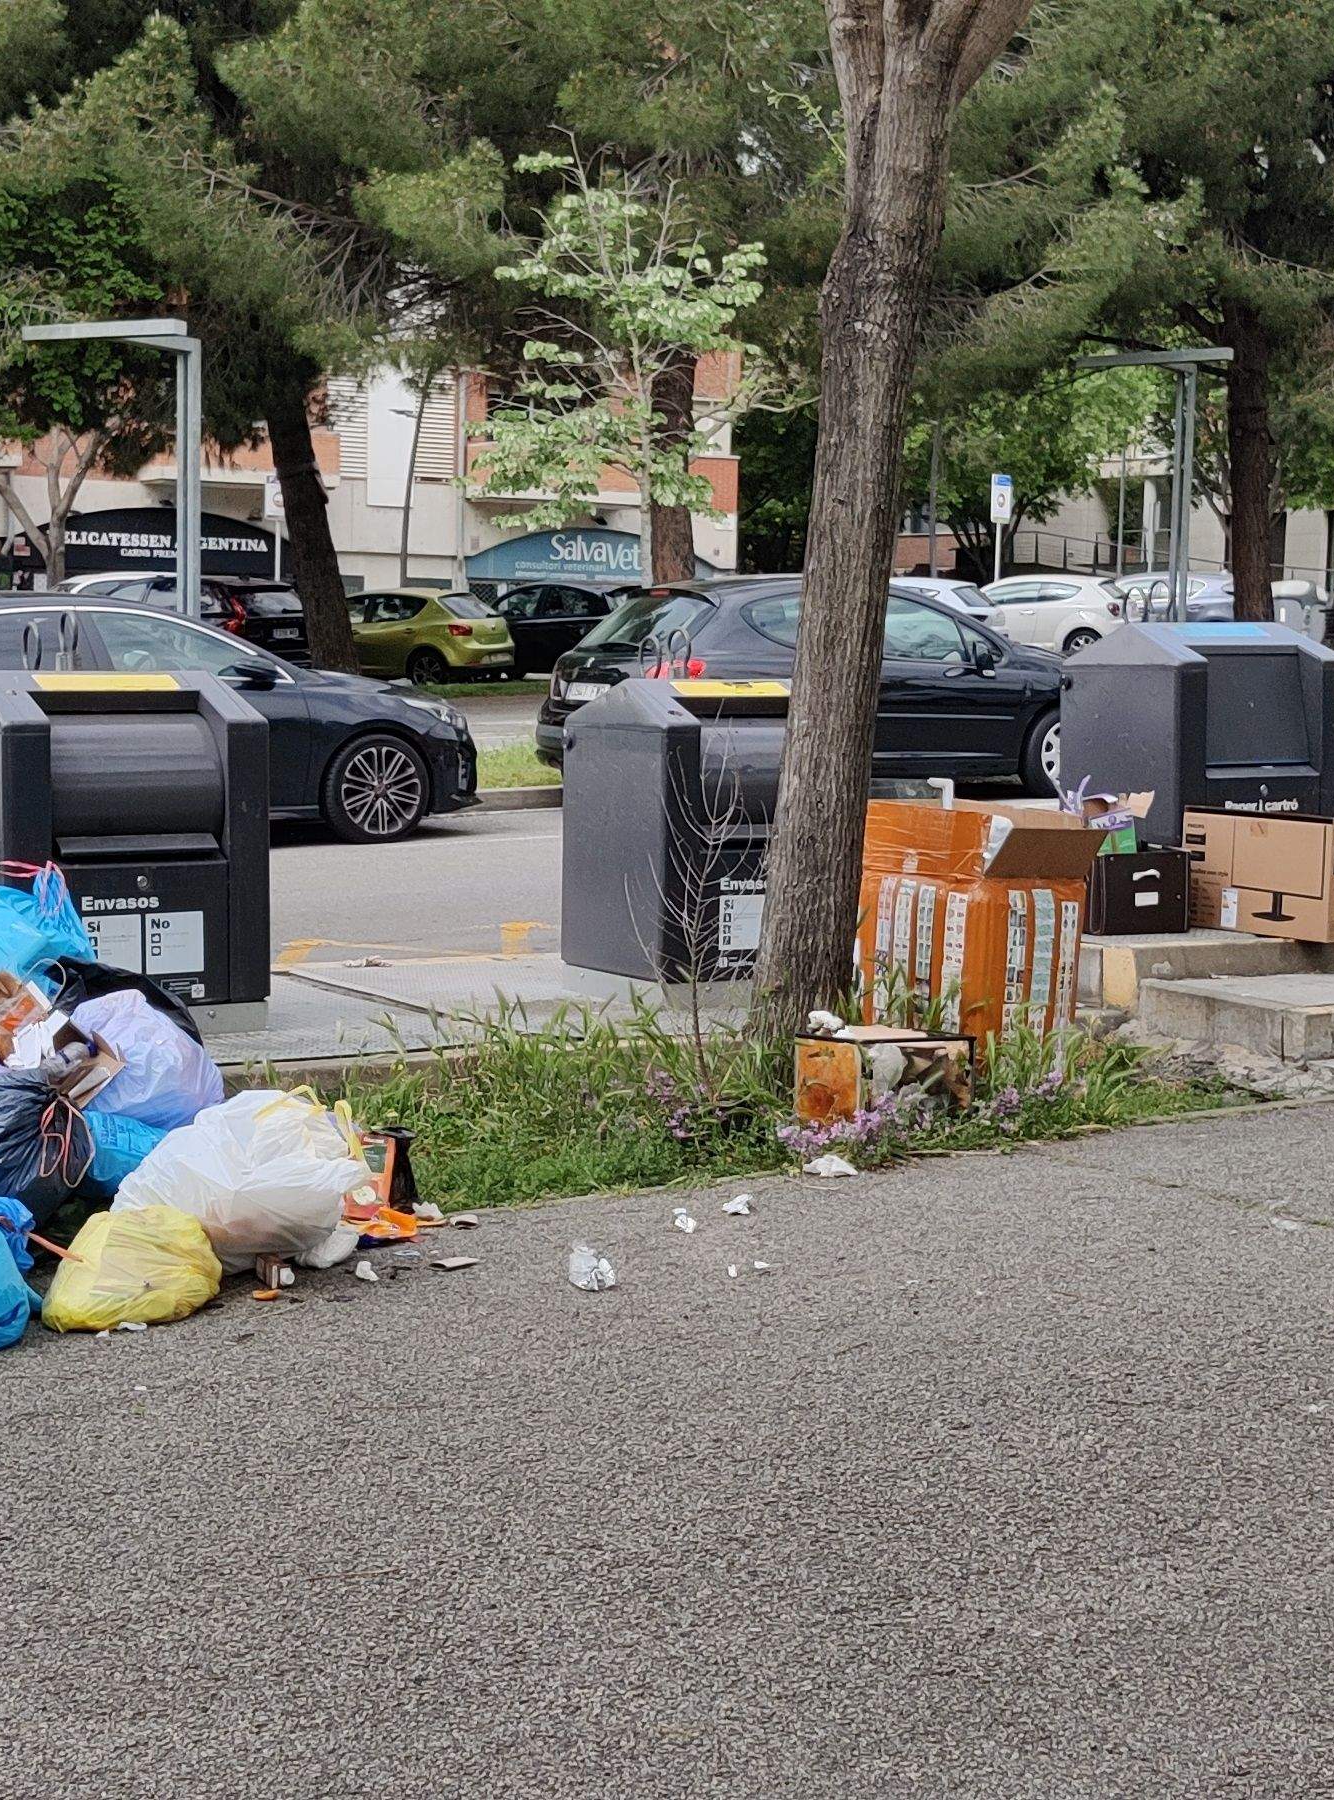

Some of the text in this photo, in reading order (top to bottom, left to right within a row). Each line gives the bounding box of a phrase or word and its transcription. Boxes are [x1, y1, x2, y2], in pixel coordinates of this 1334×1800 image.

[64, 531, 268, 553] ELICATESSEN GENTINA
[515, 560, 606, 572] consultori veterinari
[720, 876, 767, 891] Envas
[81, 896, 160, 911] Envasos
[87, 918, 171, 933] Sí No
